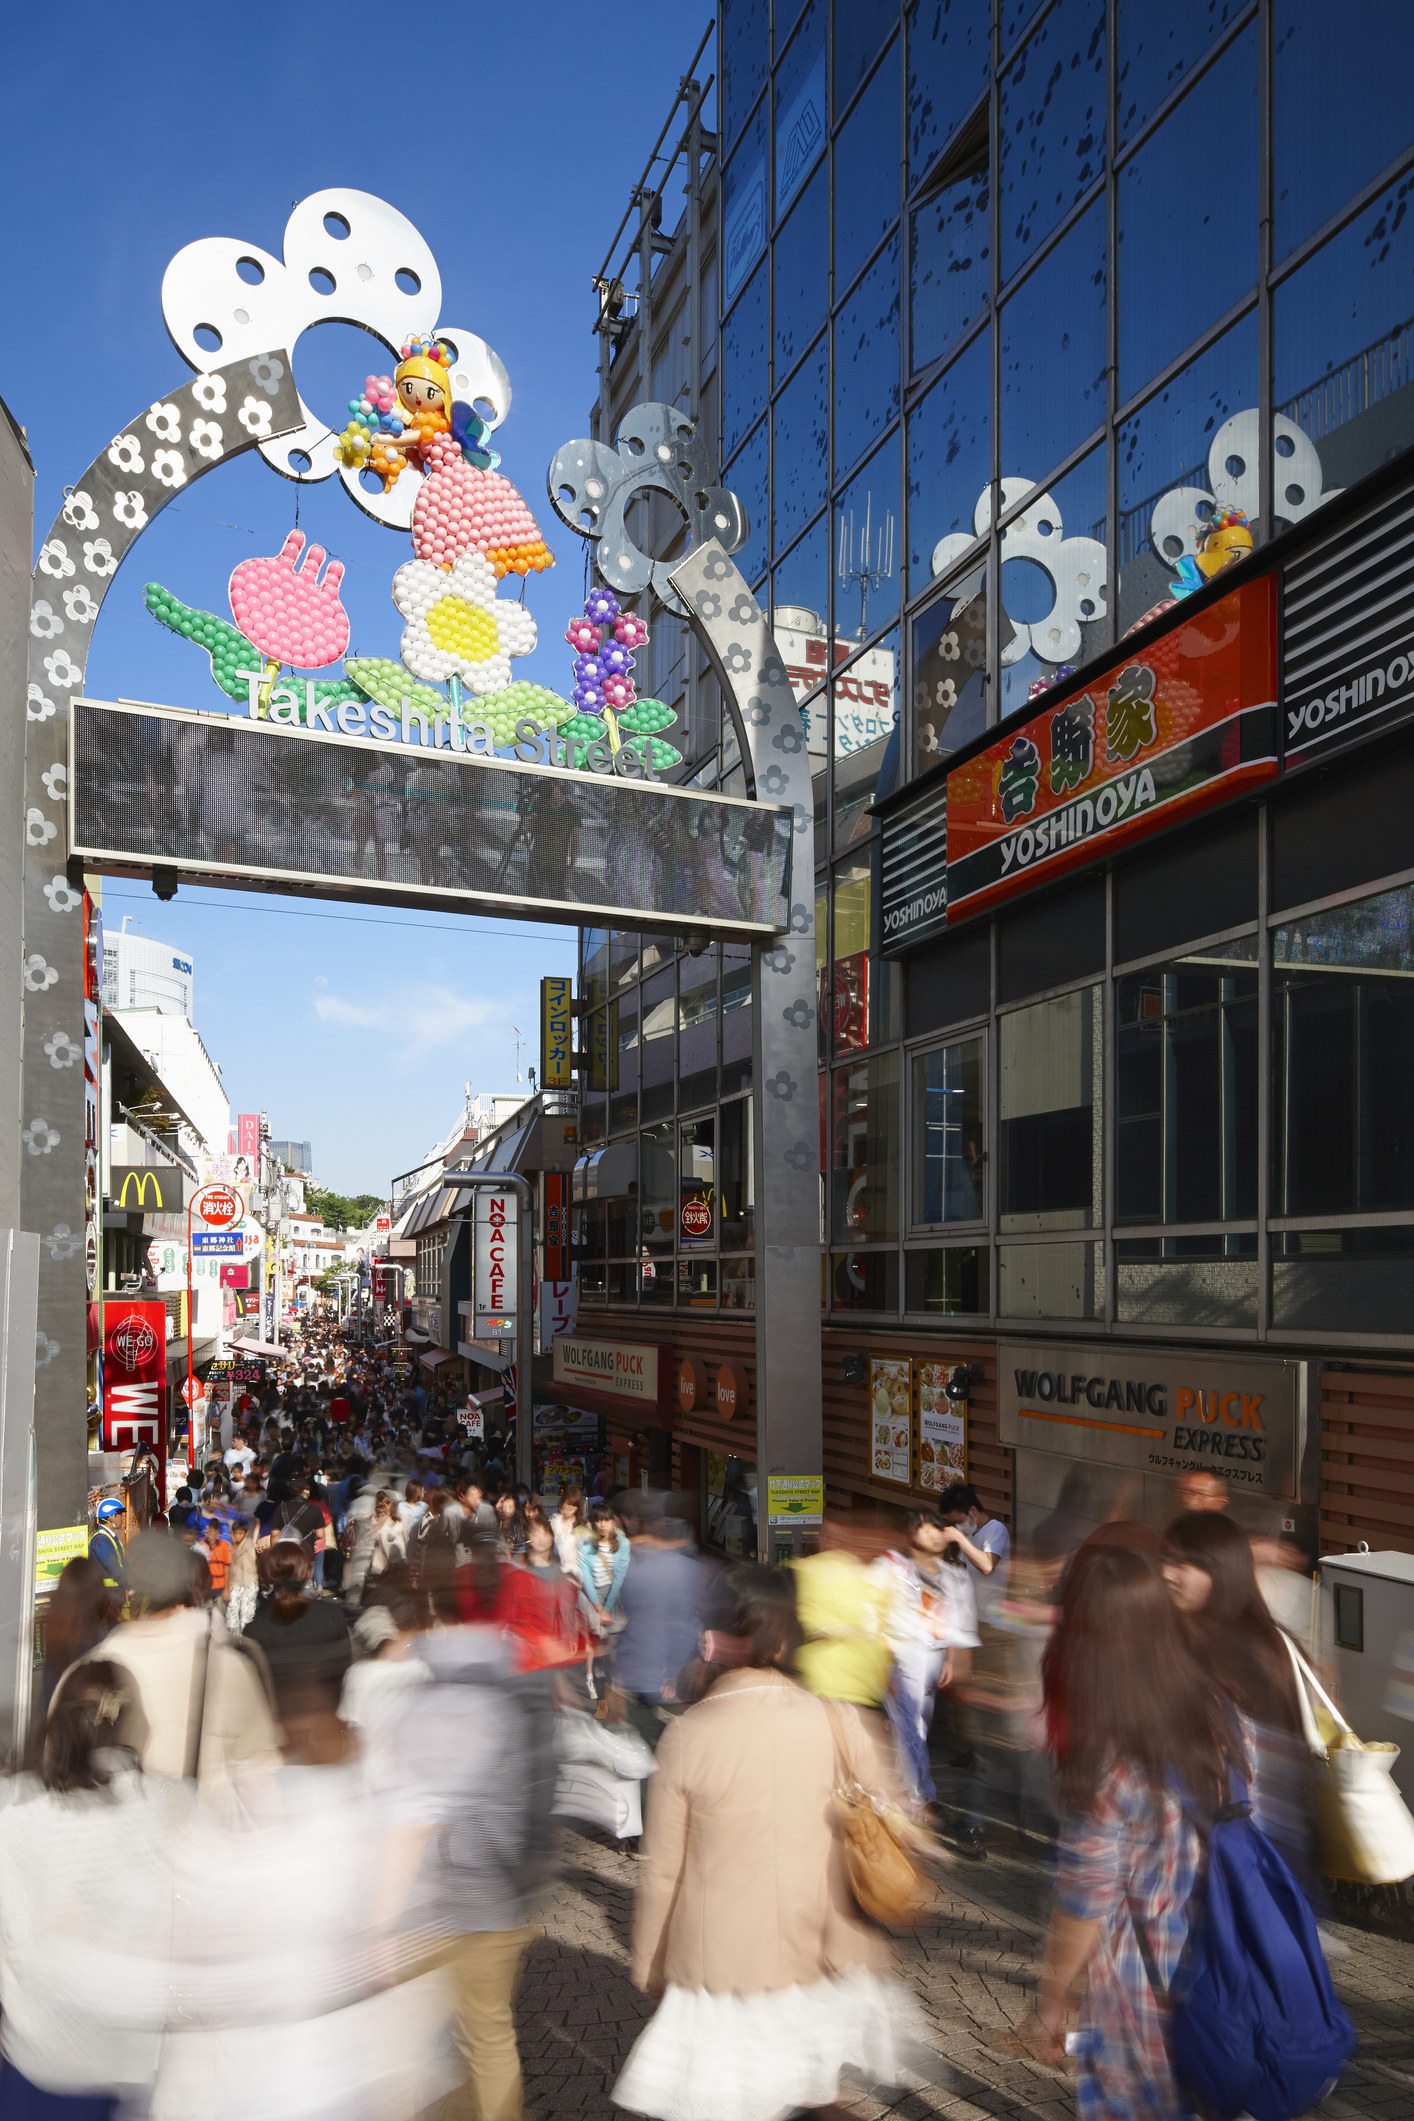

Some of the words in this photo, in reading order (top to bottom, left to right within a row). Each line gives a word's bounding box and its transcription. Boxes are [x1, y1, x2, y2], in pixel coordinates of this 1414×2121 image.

[235, 670, 496, 756] Takeshita
[515, 718, 661, 782] Street
[998, 665, 1157, 824] 吉野家
[1000, 768, 1156, 874] YOSHINOYA
[884, 887, 948, 933] YOSHINOYA
[548, 980, 568, 1075] コインロッカー
[547, 1077, 568, 1085] 3F
[203, 1201, 233, 1216] 消火栓
[489, 1198, 505, 1243] NOA
[489, 1247, 505, 1309] CAFE
[226, 1370, 260, 1380] ¥324
[563, 1345, 614, 1370] WOLFGANG
[616, 1352, 643, 1375] PUCK
[615, 1376, 643, 1391] EXPRESS
[680, 1376, 694, 1396] live
[718, 1382, 735, 1403] love
[1014, 1369, 1167, 1416] WOLFGANG
[1177, 1387, 1265, 1430] PUCK
[1174, 1426, 1266, 1462] EXPRESS
